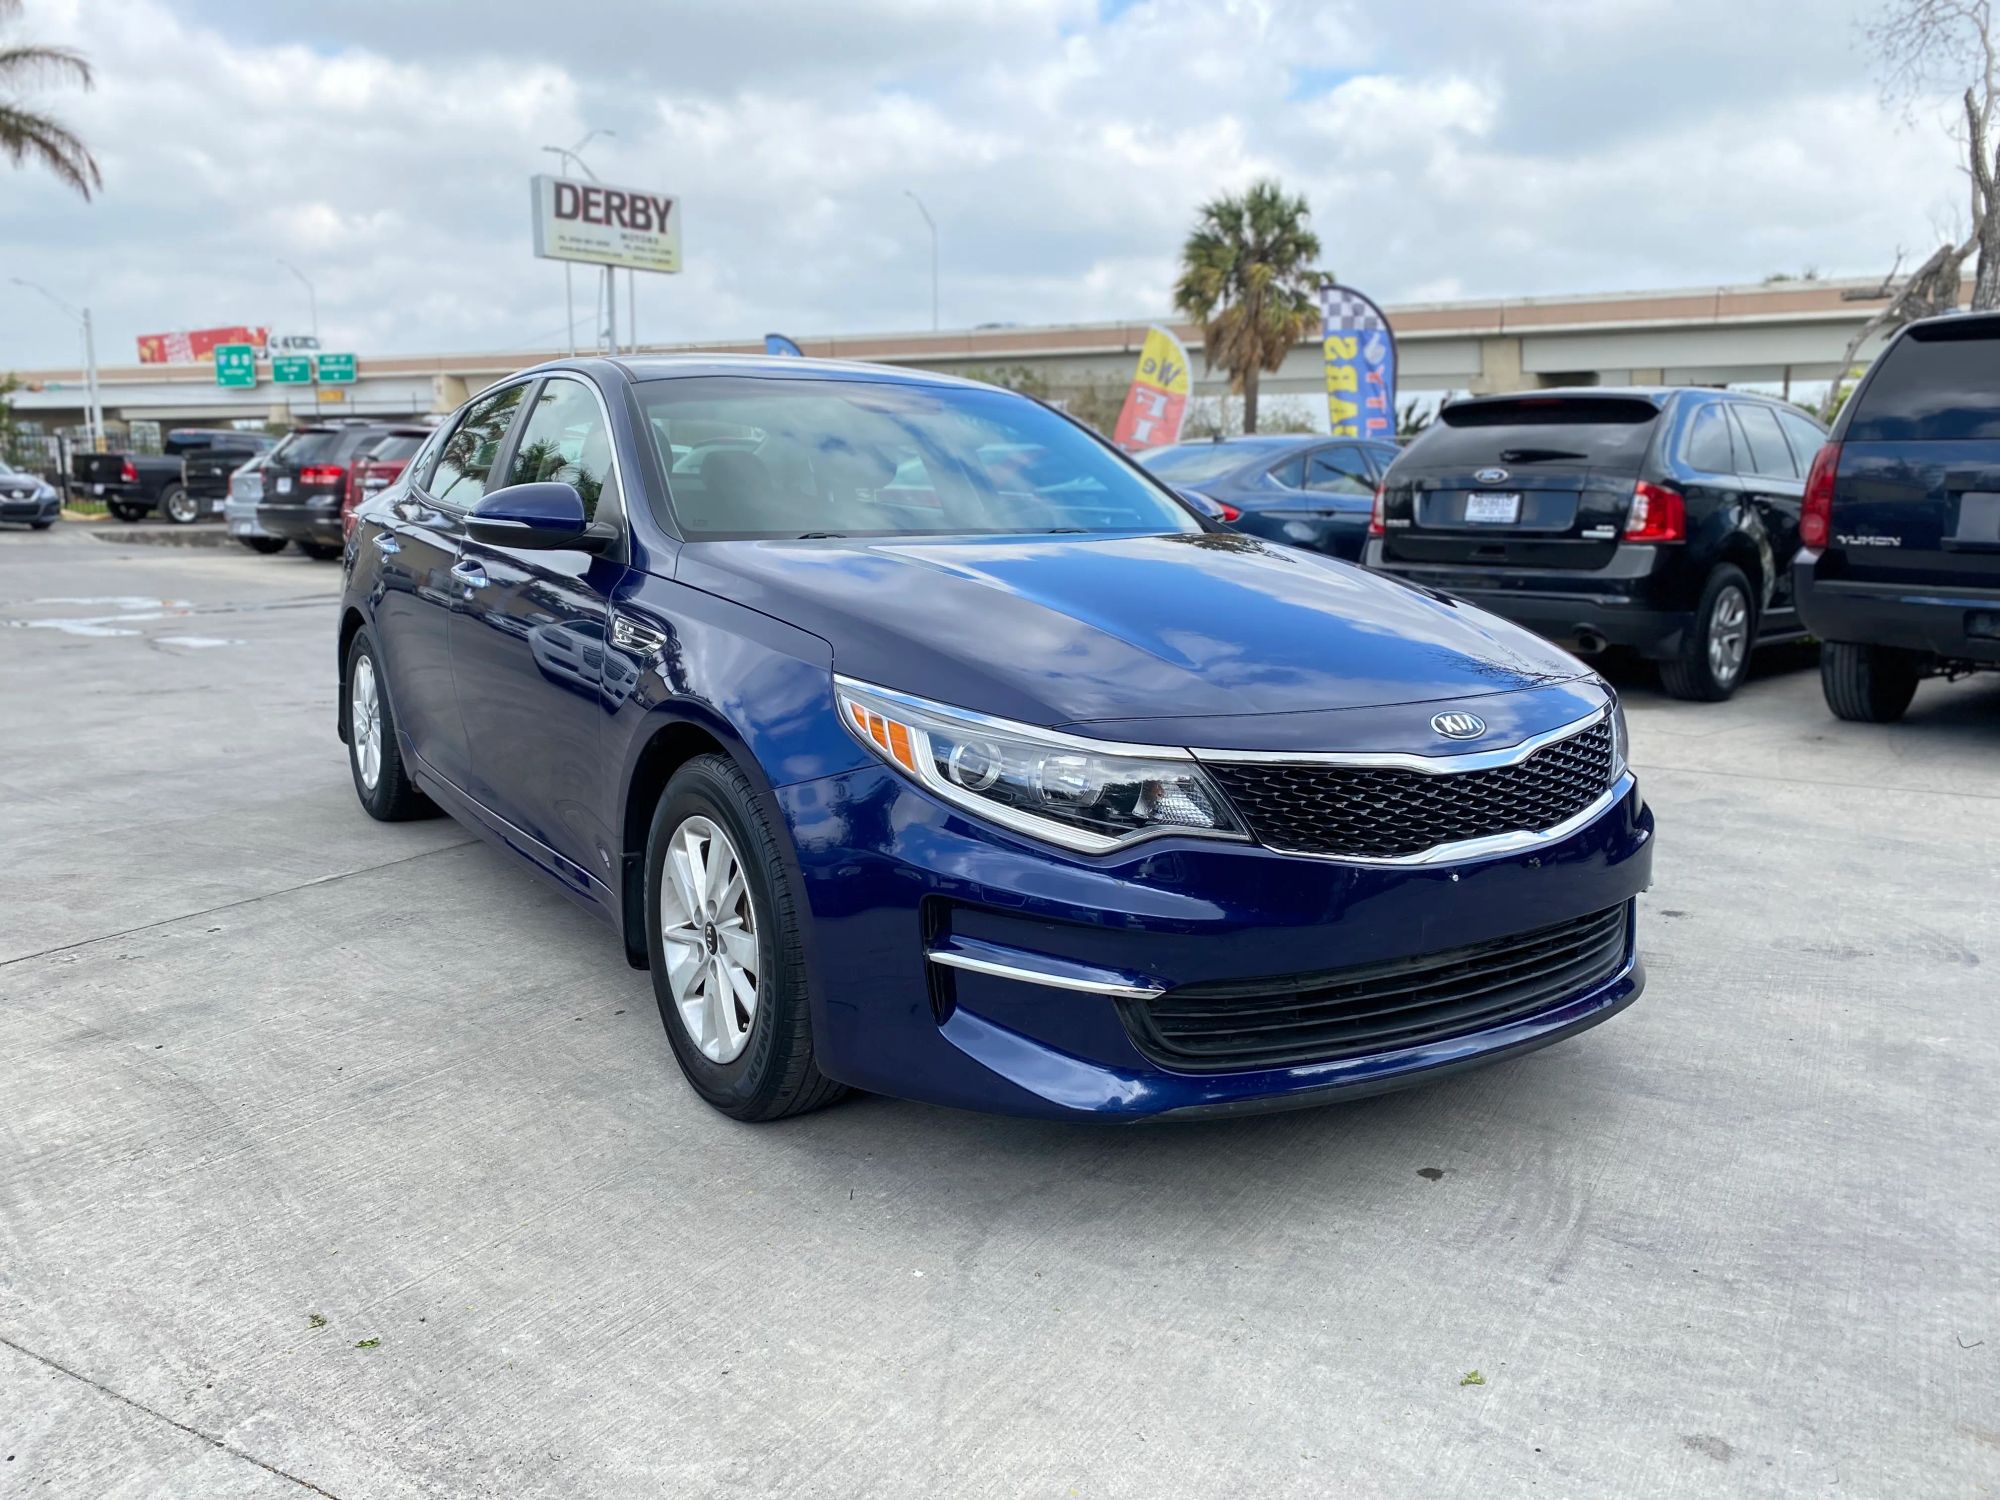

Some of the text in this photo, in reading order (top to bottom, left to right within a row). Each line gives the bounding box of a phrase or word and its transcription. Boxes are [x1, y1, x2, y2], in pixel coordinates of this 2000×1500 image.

[554, 182, 673, 234] DERBY
[1836, 535, 1902, 547] YUKON
[1437, 714, 1481, 733] KIA
[747, 942, 774, 1085] IRONMAN
